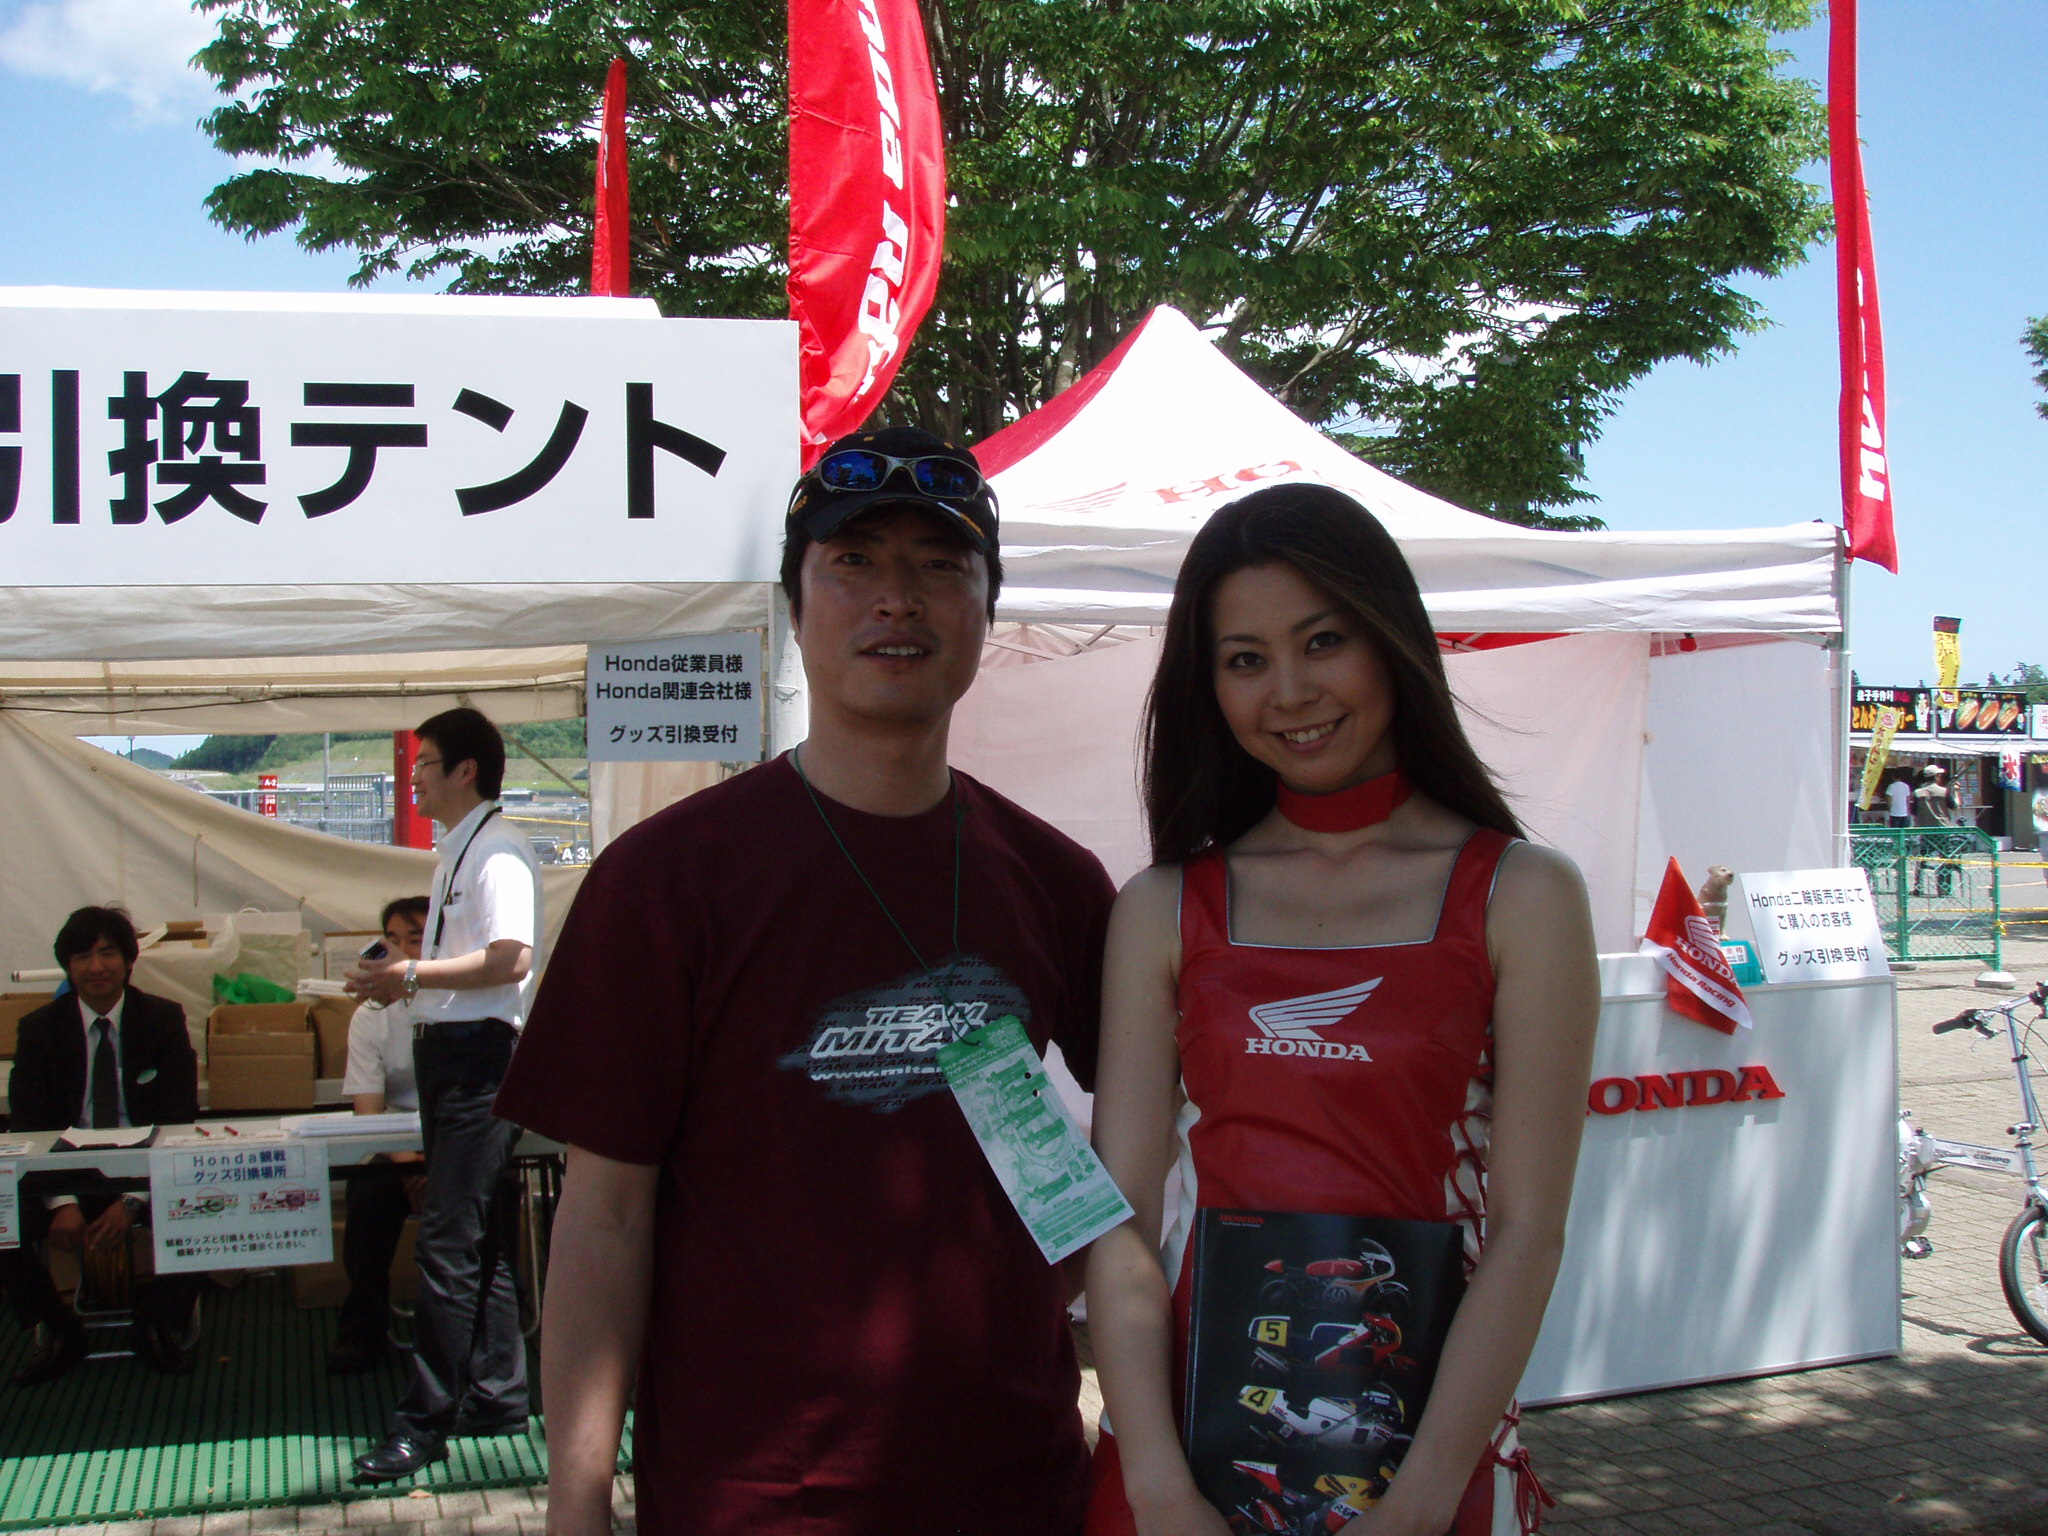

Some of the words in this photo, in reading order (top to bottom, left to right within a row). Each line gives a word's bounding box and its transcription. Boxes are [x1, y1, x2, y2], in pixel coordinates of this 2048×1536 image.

[605, 654, 743, 673] Honda従業員様
[596, 681, 752, 701] Honda関連会社様
[610, 725, 738, 744] グッズ引換受付
[1750, 888, 1865, 908] Honda二輪販売店にて
[1777, 911, 1853, 930] ご購入のお客様
[1777, 945, 1869, 966] グッズ引換受付
[1666, 952, 1698, 982] Honda
[1697, 979, 1737, 1008] Racing
[866, 1002, 988, 1027] TEAM
[810, 1023, 985, 1058] MITA
[1245, 1037, 1374, 1063] HONDA
[1586, 1065, 1786, 1116] ONDA
[193, 1149, 287, 1167] Honda観戦
[1973, 1154, 2011, 1164] COMPO
[194, 1165, 287, 1184] グッズ引換場所
[1219, 1215, 1265, 1224] HONDA
[1265, 1321, 1281, 1342] 5
[1248, 1389, 1268, 1407] 4
